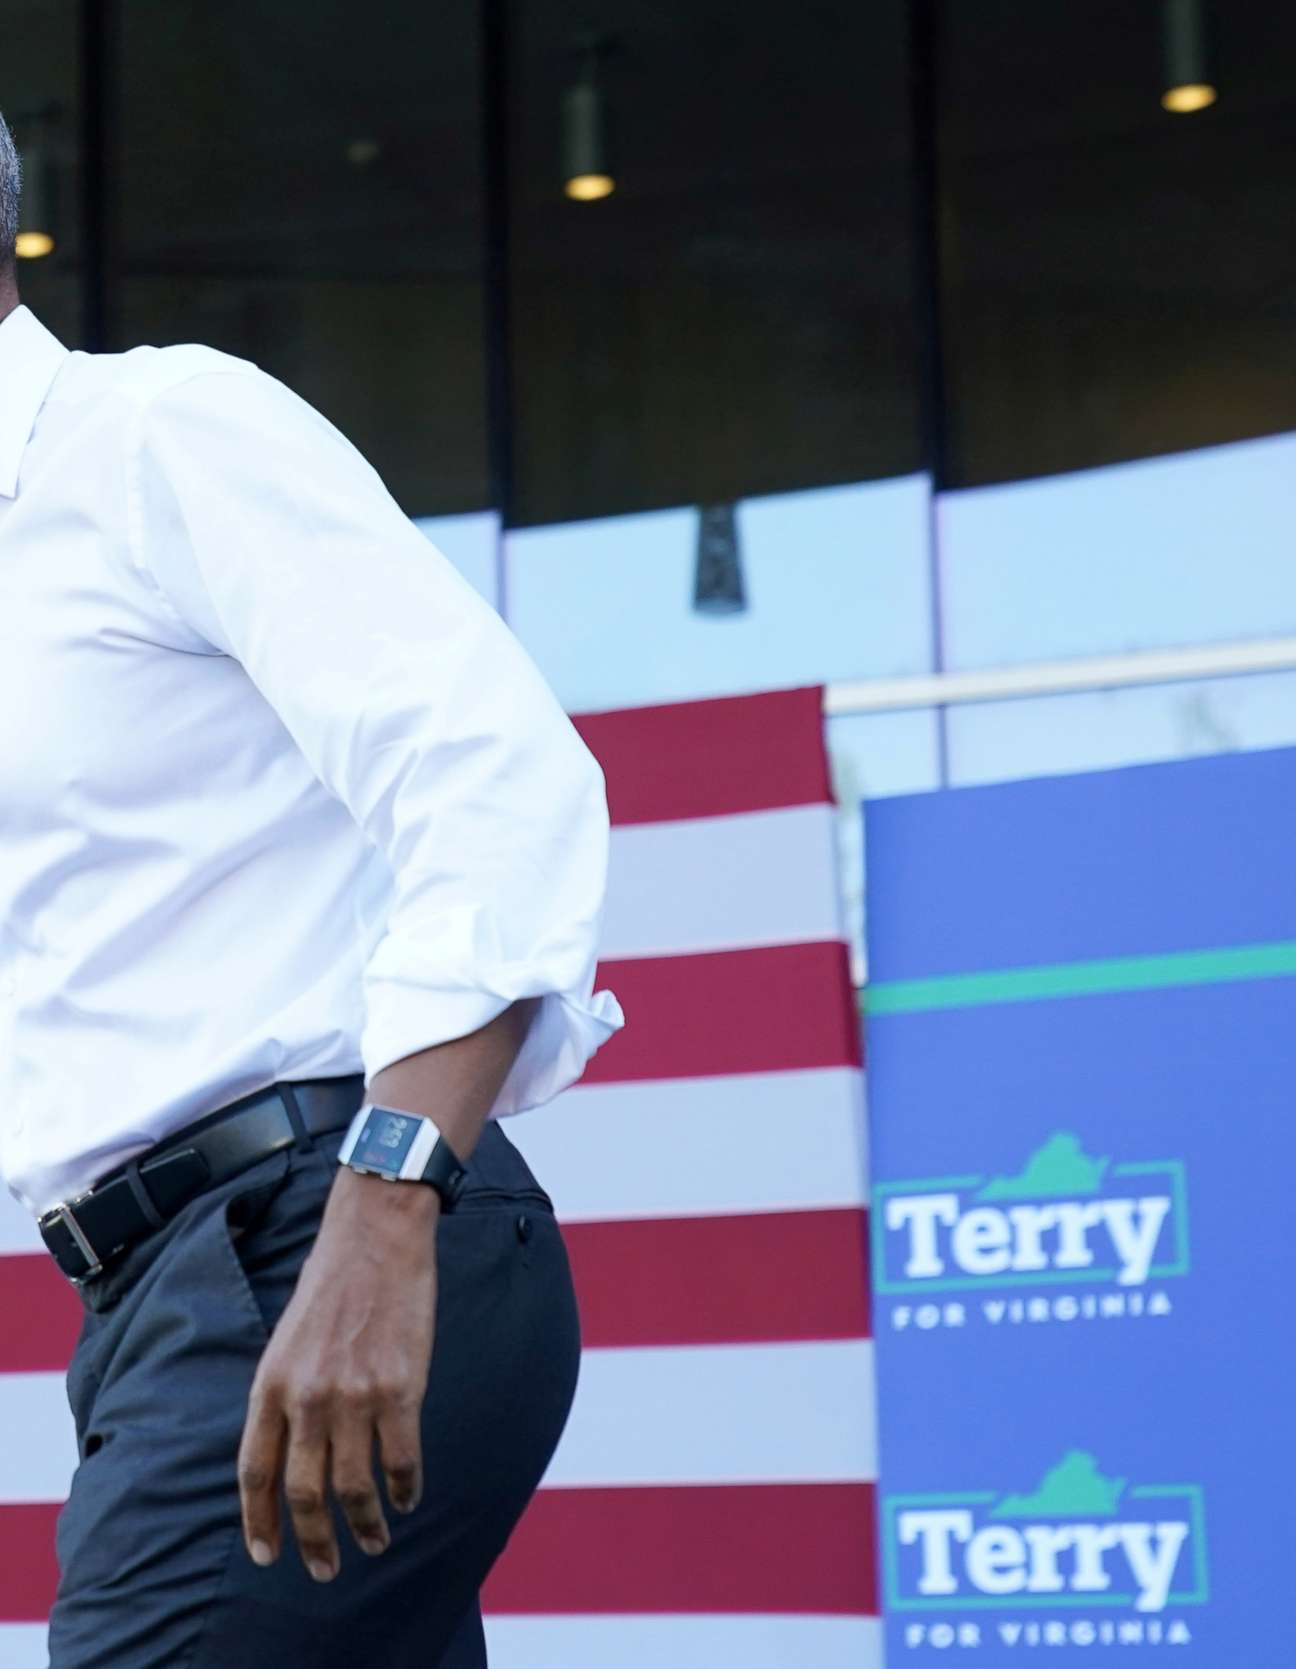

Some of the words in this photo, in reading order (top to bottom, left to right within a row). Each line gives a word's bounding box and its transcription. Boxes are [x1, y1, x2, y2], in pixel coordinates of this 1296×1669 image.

[886, 1194, 1170, 1286] Terry
[892, 1302, 966, 1330] FOR
[983, 1293, 1172, 1323] VIRGINIA
[898, 1510, 1188, 1612] Terry
[906, 1623, 981, 1649] FOR
[998, 1620, 1191, 1646] VIRGINIA
